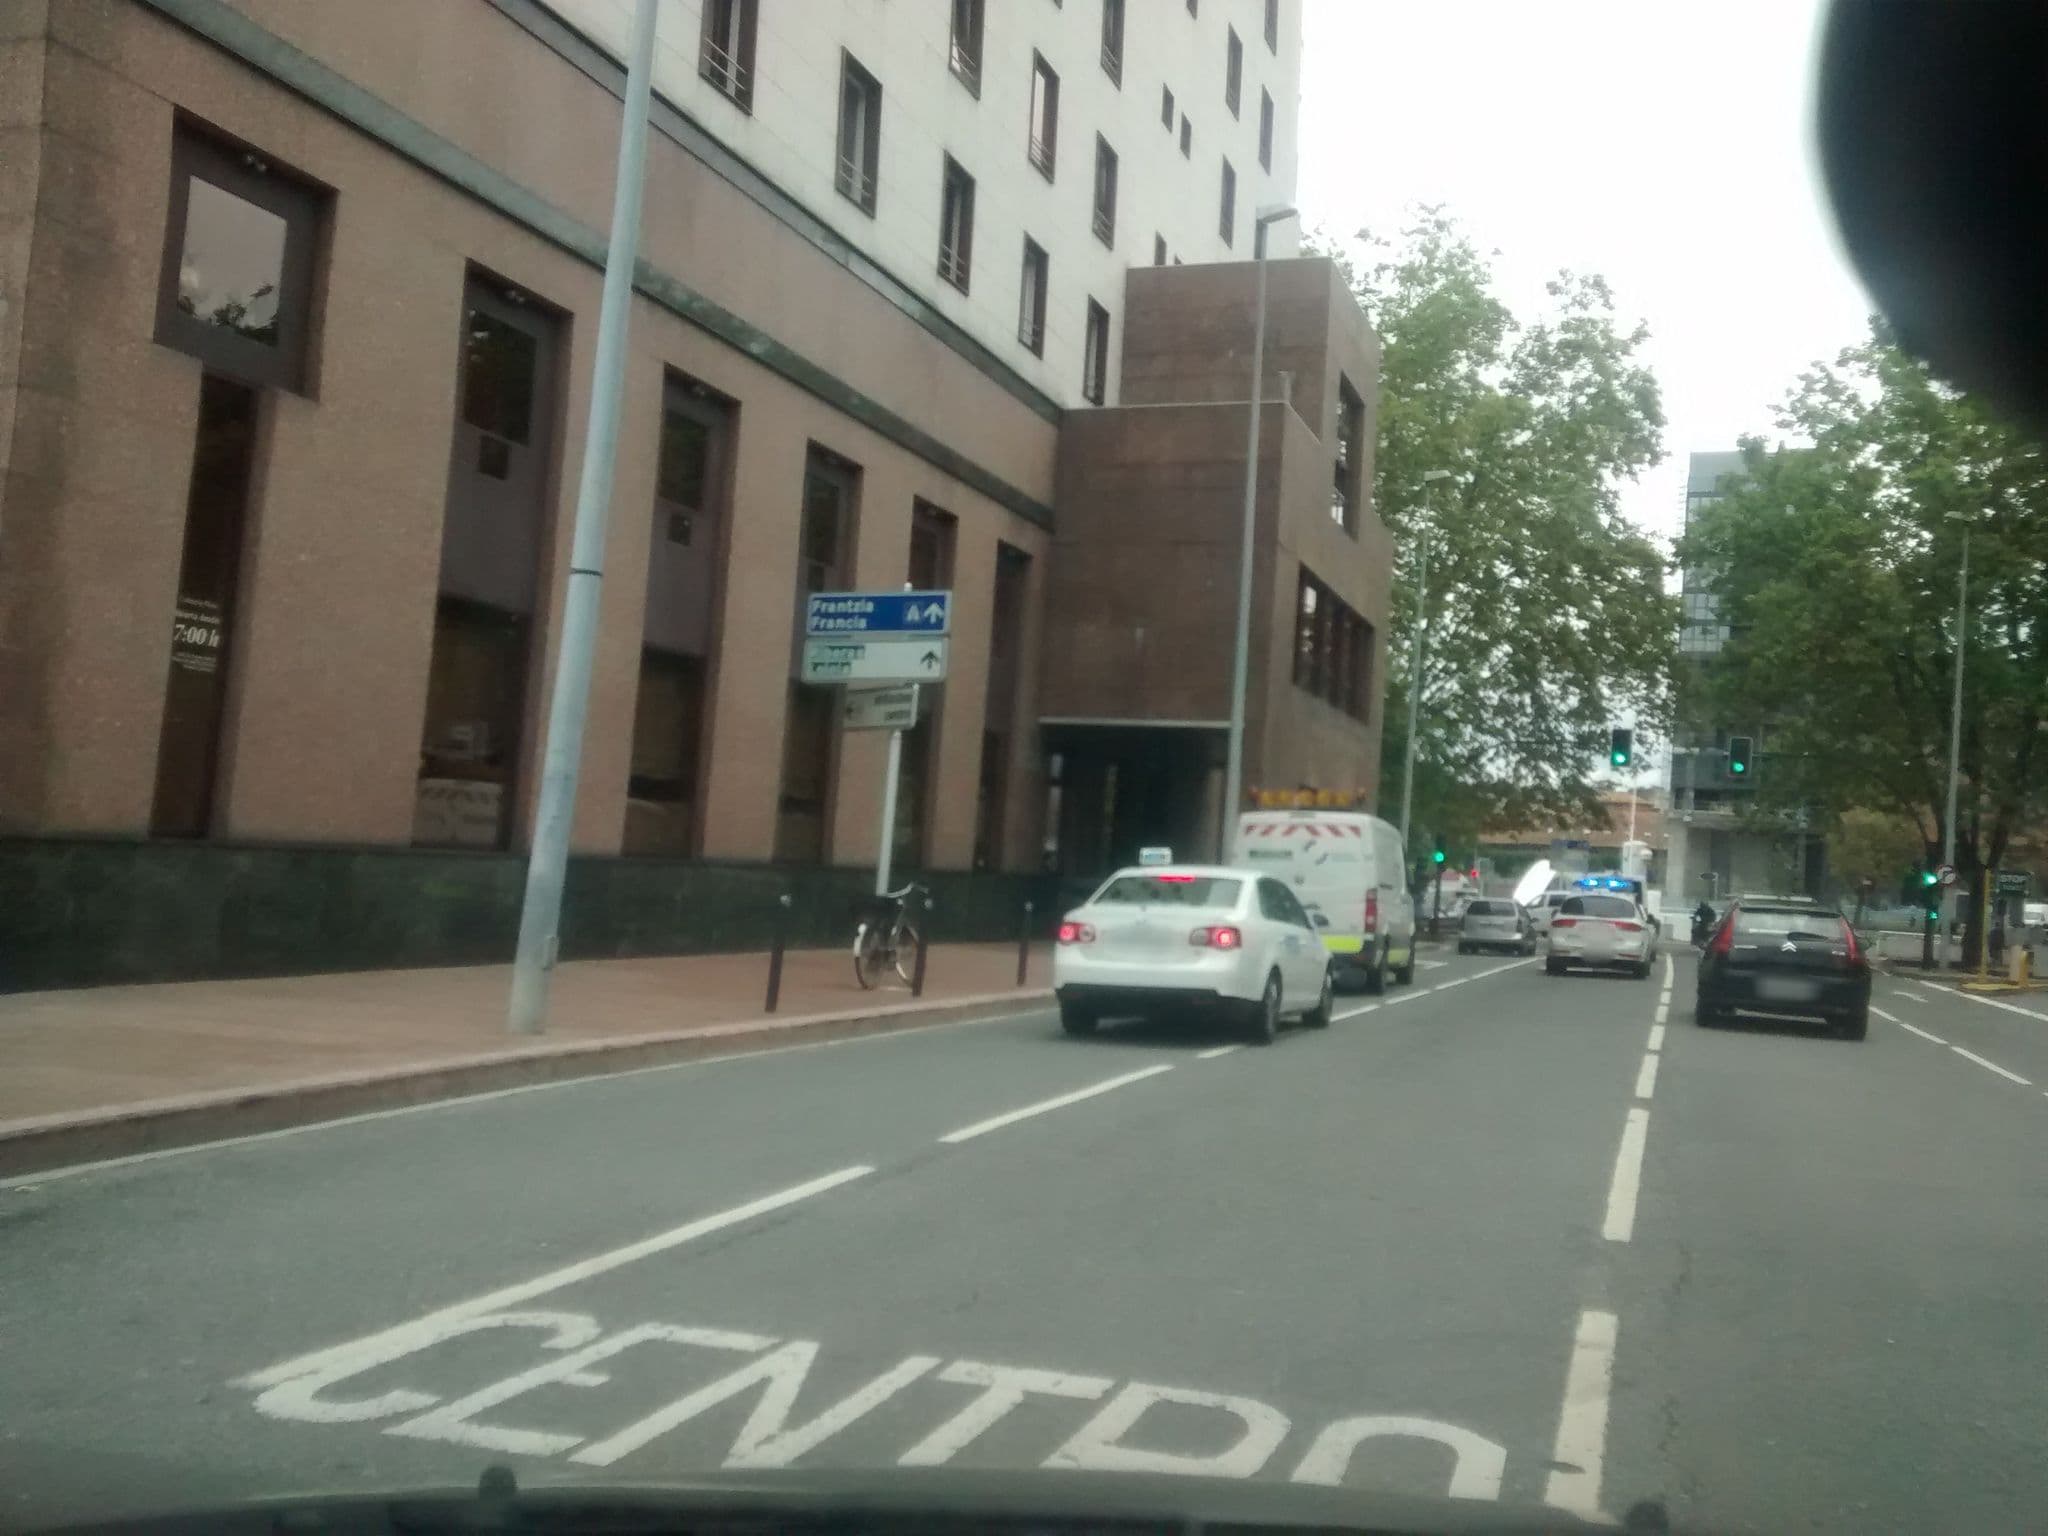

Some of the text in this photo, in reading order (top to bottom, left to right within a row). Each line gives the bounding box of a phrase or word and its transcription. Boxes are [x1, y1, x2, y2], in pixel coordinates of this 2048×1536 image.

[810, 599, 874, 614] Frantzia
[809, 614, 867, 630] Francia
[174, 623, 207, 645] 7:00
